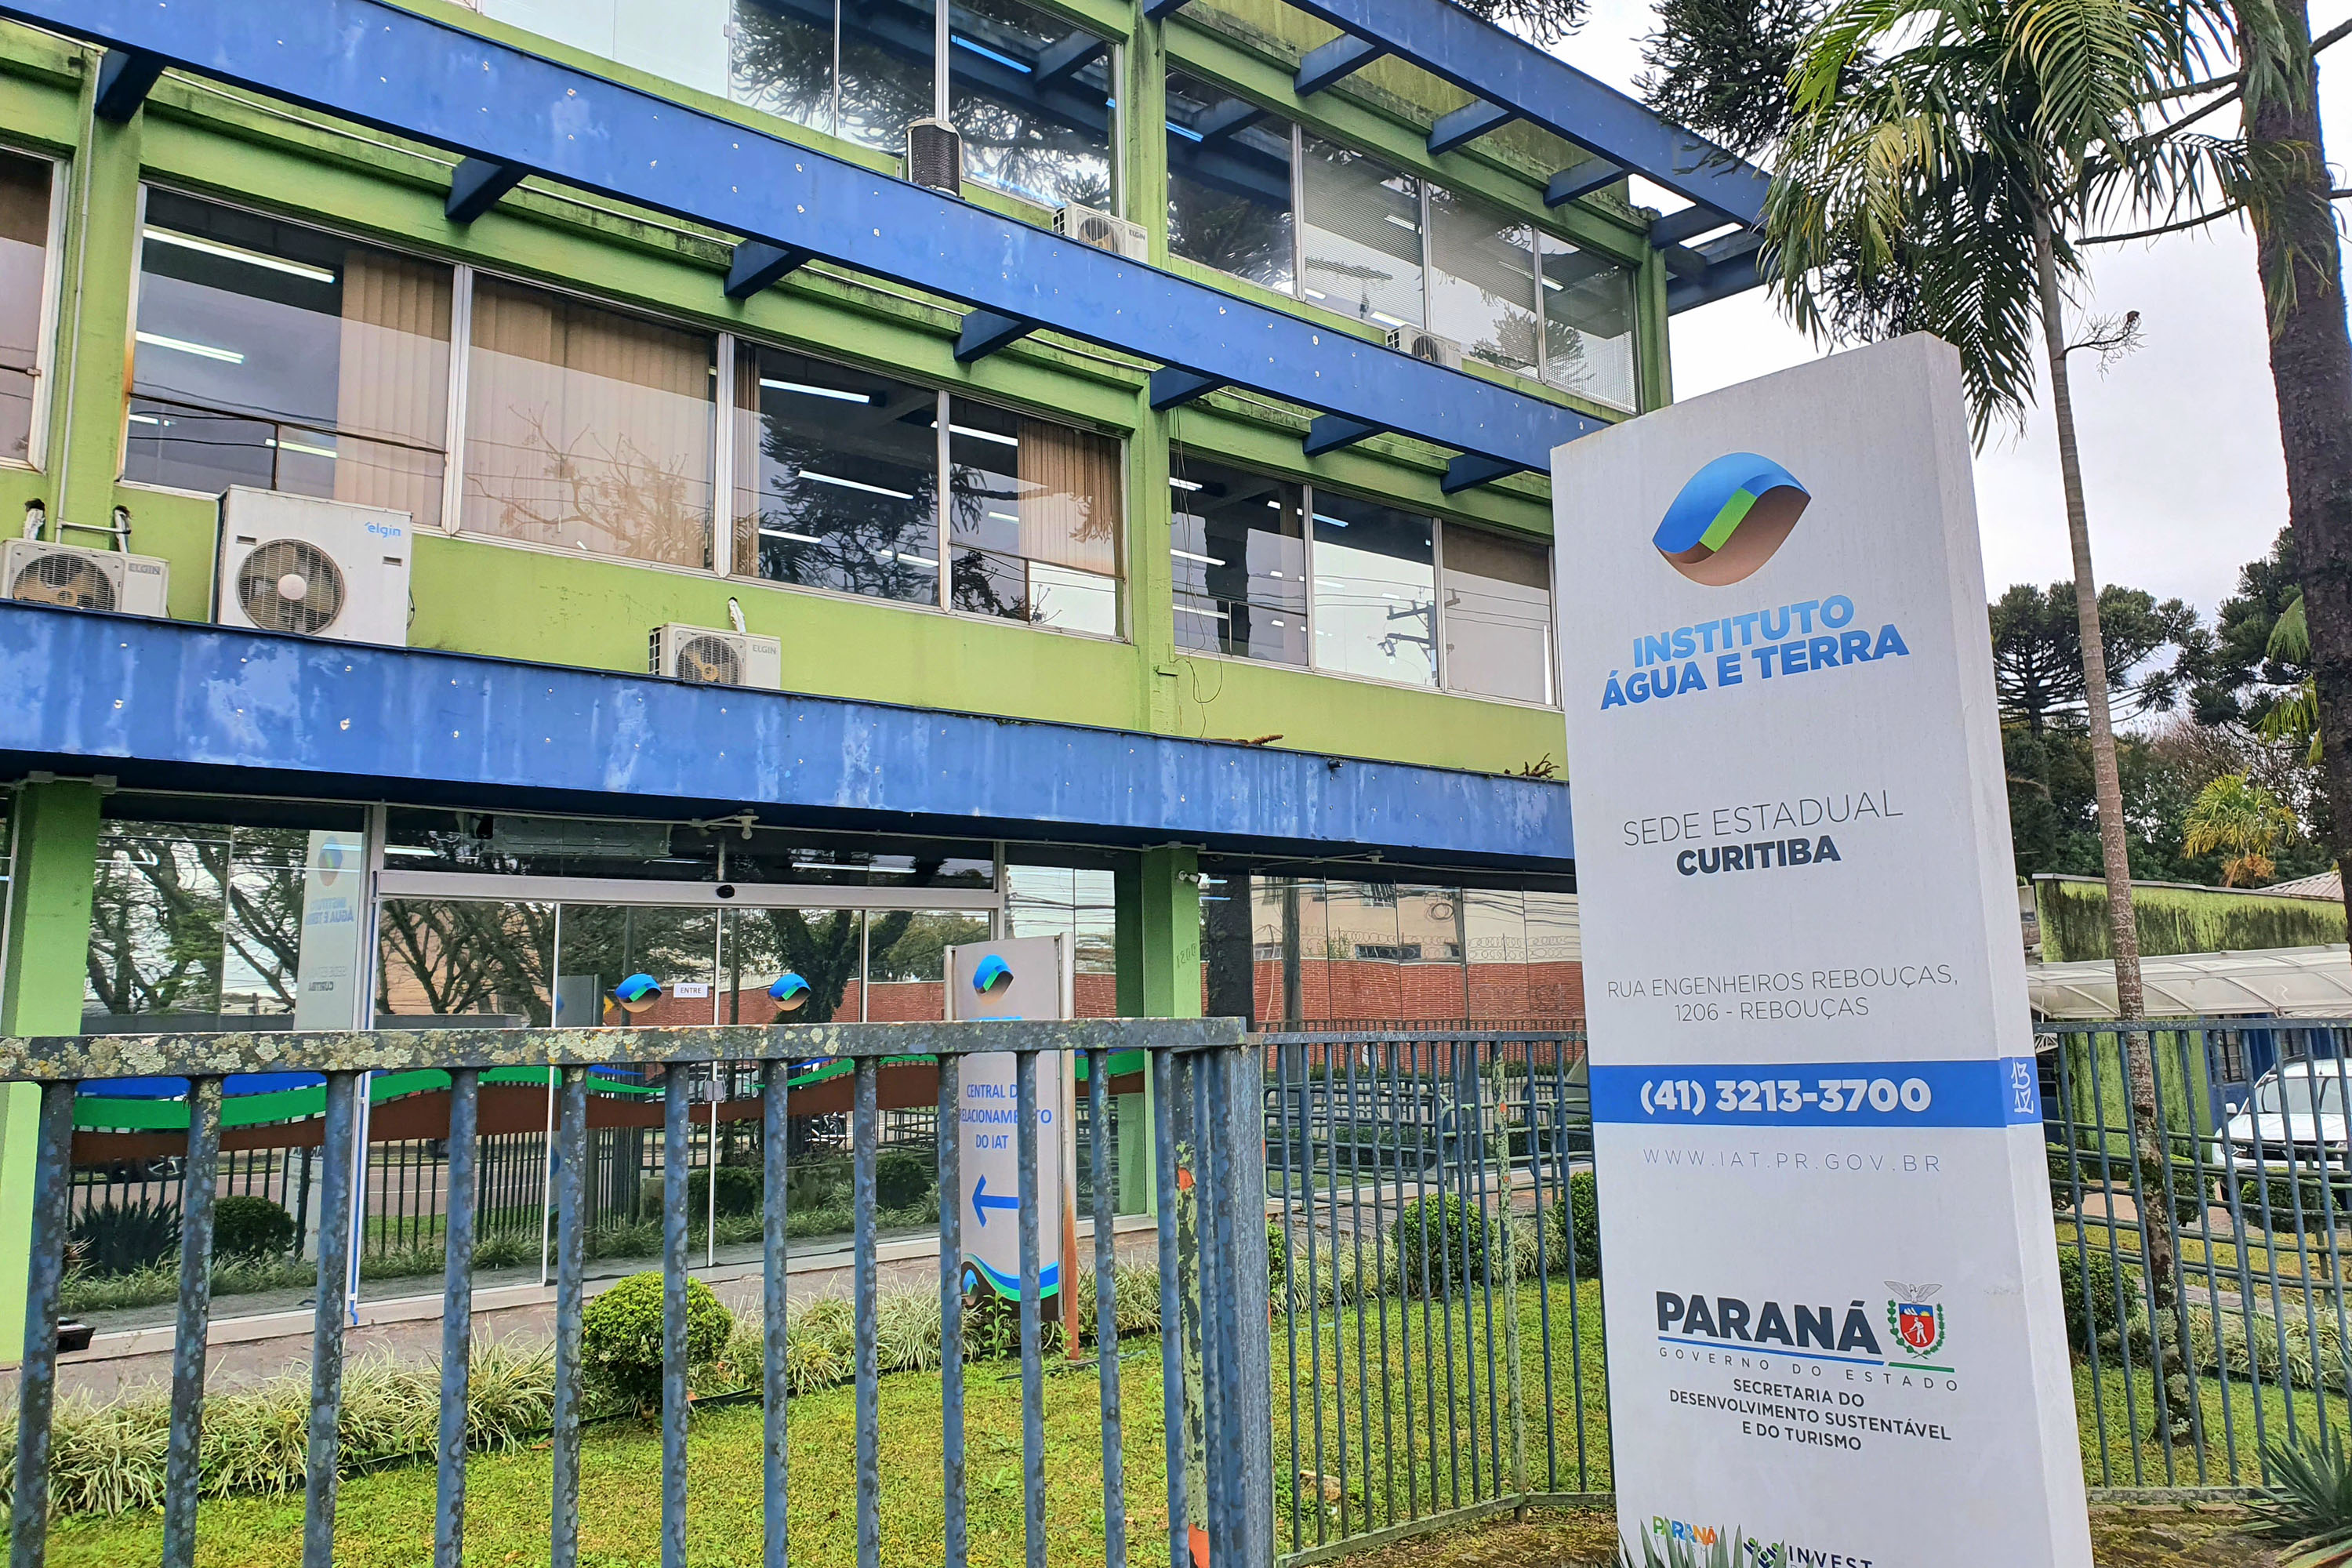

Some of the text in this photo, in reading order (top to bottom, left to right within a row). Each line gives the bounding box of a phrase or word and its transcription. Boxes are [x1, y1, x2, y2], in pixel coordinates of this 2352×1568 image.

[365, 521, 401, 539] elgin
[129, 563, 161, 575] ELGIN
[1633, 594, 1855, 668] INSTITUTO
[753, 644, 776, 654] ELGIN
[1600, 623, 1910, 710] ÁGUA E TERRA
[1623, 789, 1904, 847] SEDE ESTADUAL
[1676, 835, 1842, 877] CURITIBA
[1607, 964, 1958, 997] RUA ENGENHEIROS REBOUÇAS,
[1675, 1003, 1719, 1022] 1206
[1740, 996, 1869, 1020] REBOUÇAS
[967, 1084, 1006, 1098] CENTRAL
[1640, 1077, 1932, 1116] (41) 3213-3700
[975, 1134, 1009, 1149] DO IAT
[1644, 1149, 1940, 1172] WWW.IAT.PR.GOV.BR
[1656, 1290, 1883, 1356] PARANÁ
[1659, 1347, 1958, 1392] GOVERNO DO ESTADO
[1733, 1378, 1864, 1407] SECRETARIA DO
[1670, 1389, 1951, 1441] DESENVOLVIMENTO SUSTENTÁVEL
[1742, 1421, 1861, 1450] E DO TURISMO
[1788, 1545, 1872, 1568] INVEST
